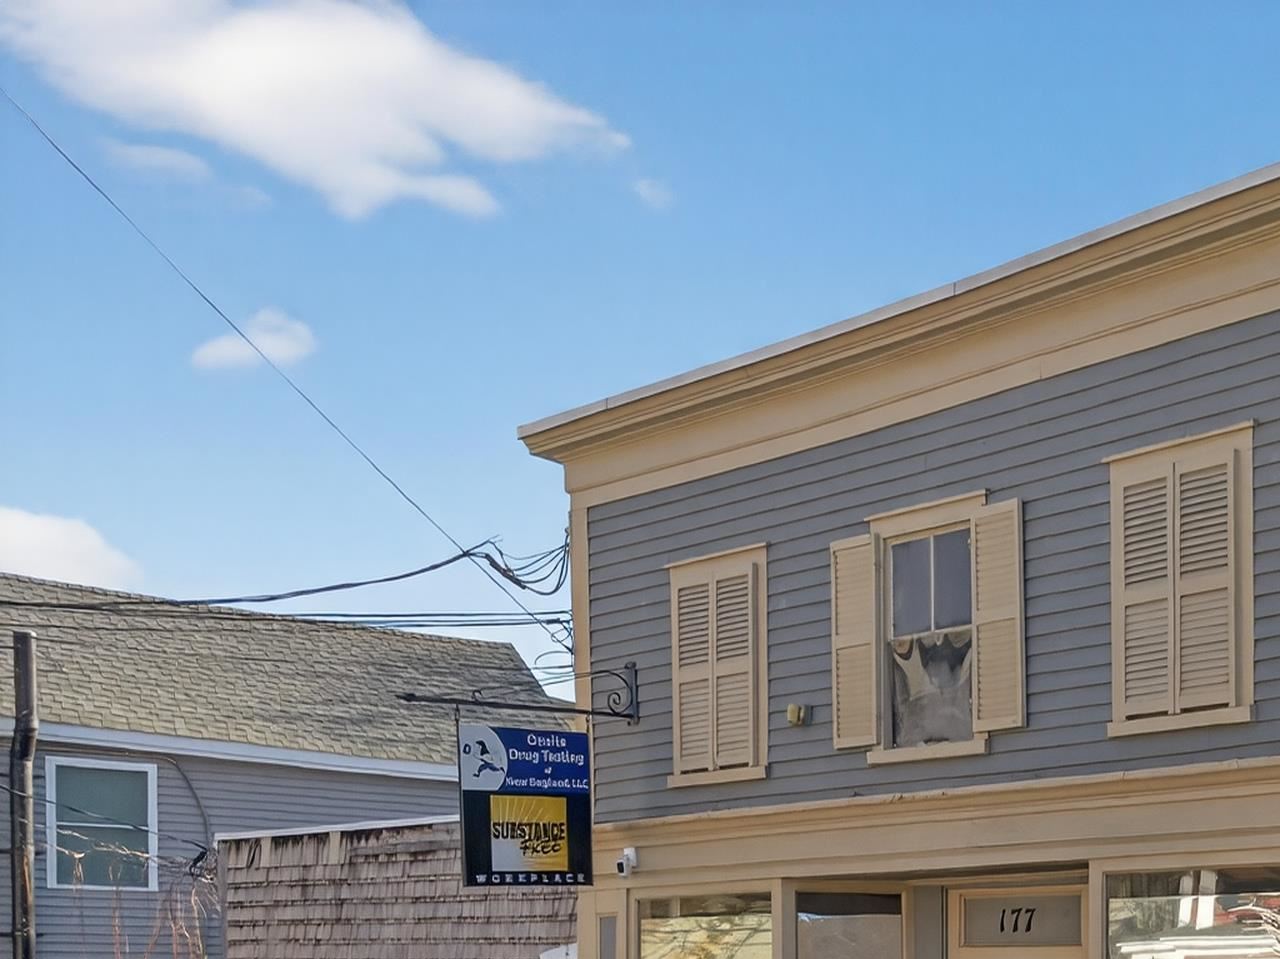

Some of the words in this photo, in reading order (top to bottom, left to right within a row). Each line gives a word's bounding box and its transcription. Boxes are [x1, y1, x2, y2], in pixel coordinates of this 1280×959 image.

[509, 748, 539, 764] Drug
[492, 821, 566, 842] SUBSTANCE
[520, 839, 563, 855] FREE
[476, 873, 585, 883] WORKPLACE
[1000, 907, 1037, 933] 177
